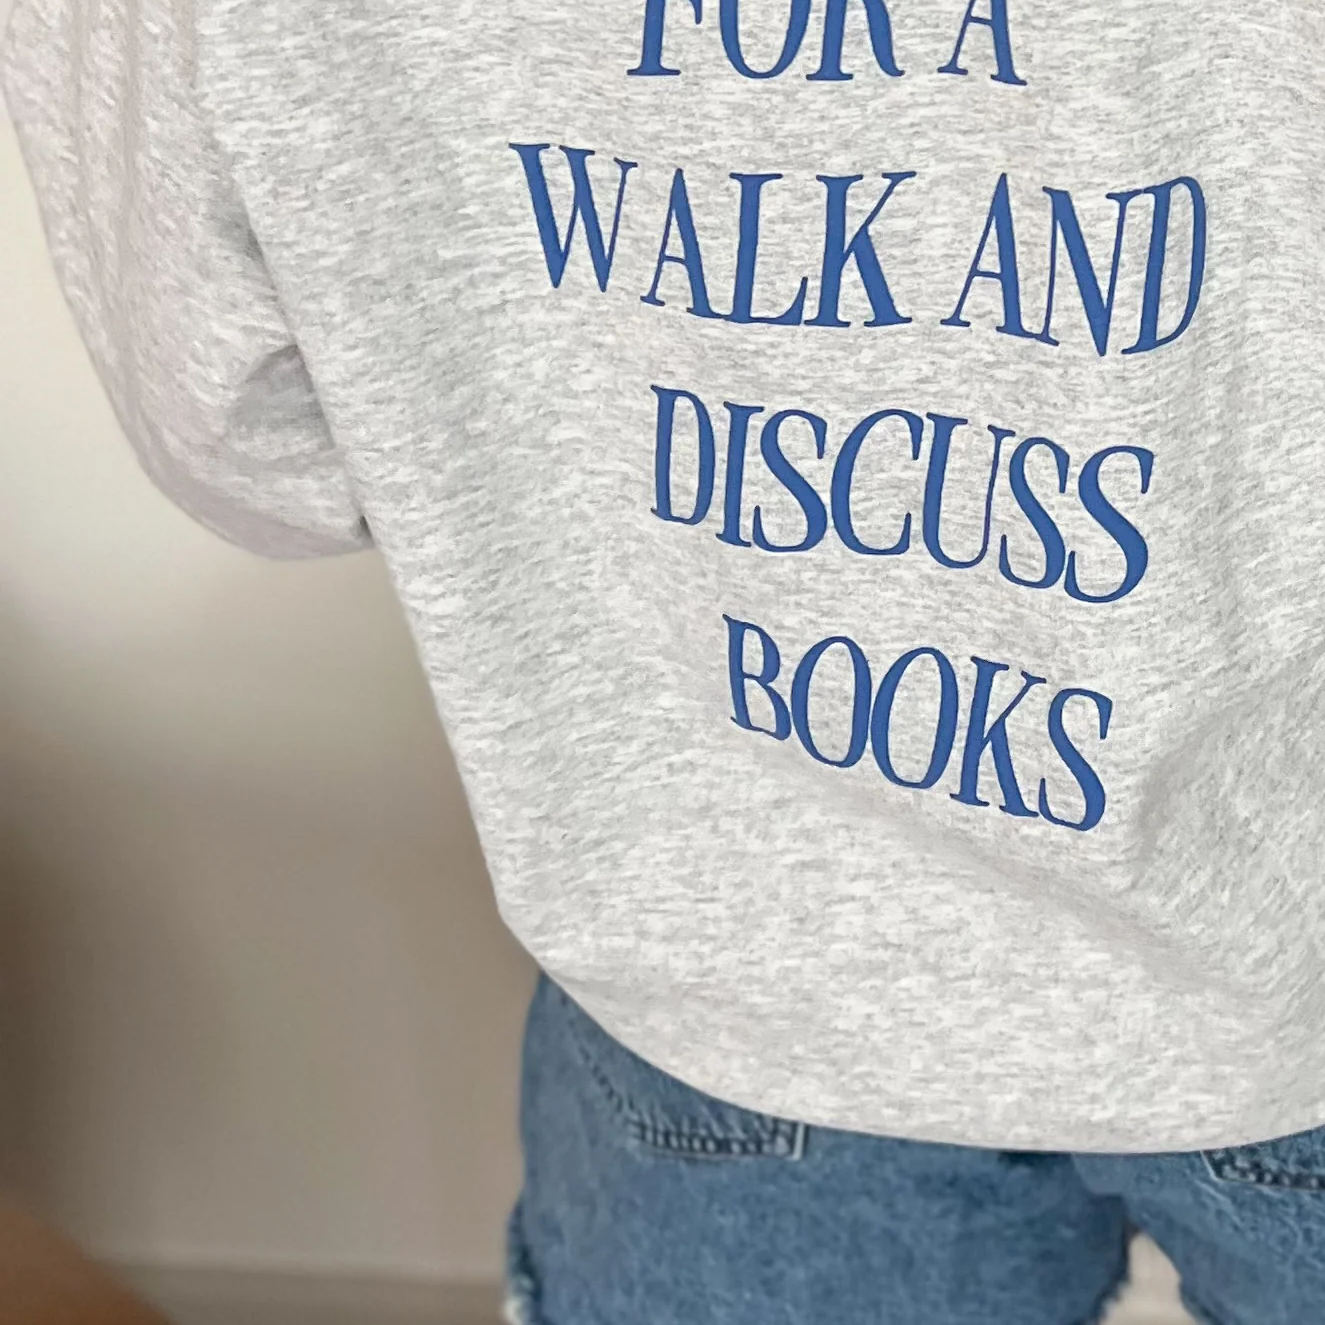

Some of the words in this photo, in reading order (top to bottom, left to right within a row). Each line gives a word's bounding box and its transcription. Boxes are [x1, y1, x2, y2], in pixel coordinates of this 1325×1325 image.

[508, 143, 918, 328] WALK
[940, 172, 1207, 357] AND
[650, 384, 1155, 604] DISCUSS
[721, 613, 1114, 832] BOOKS
